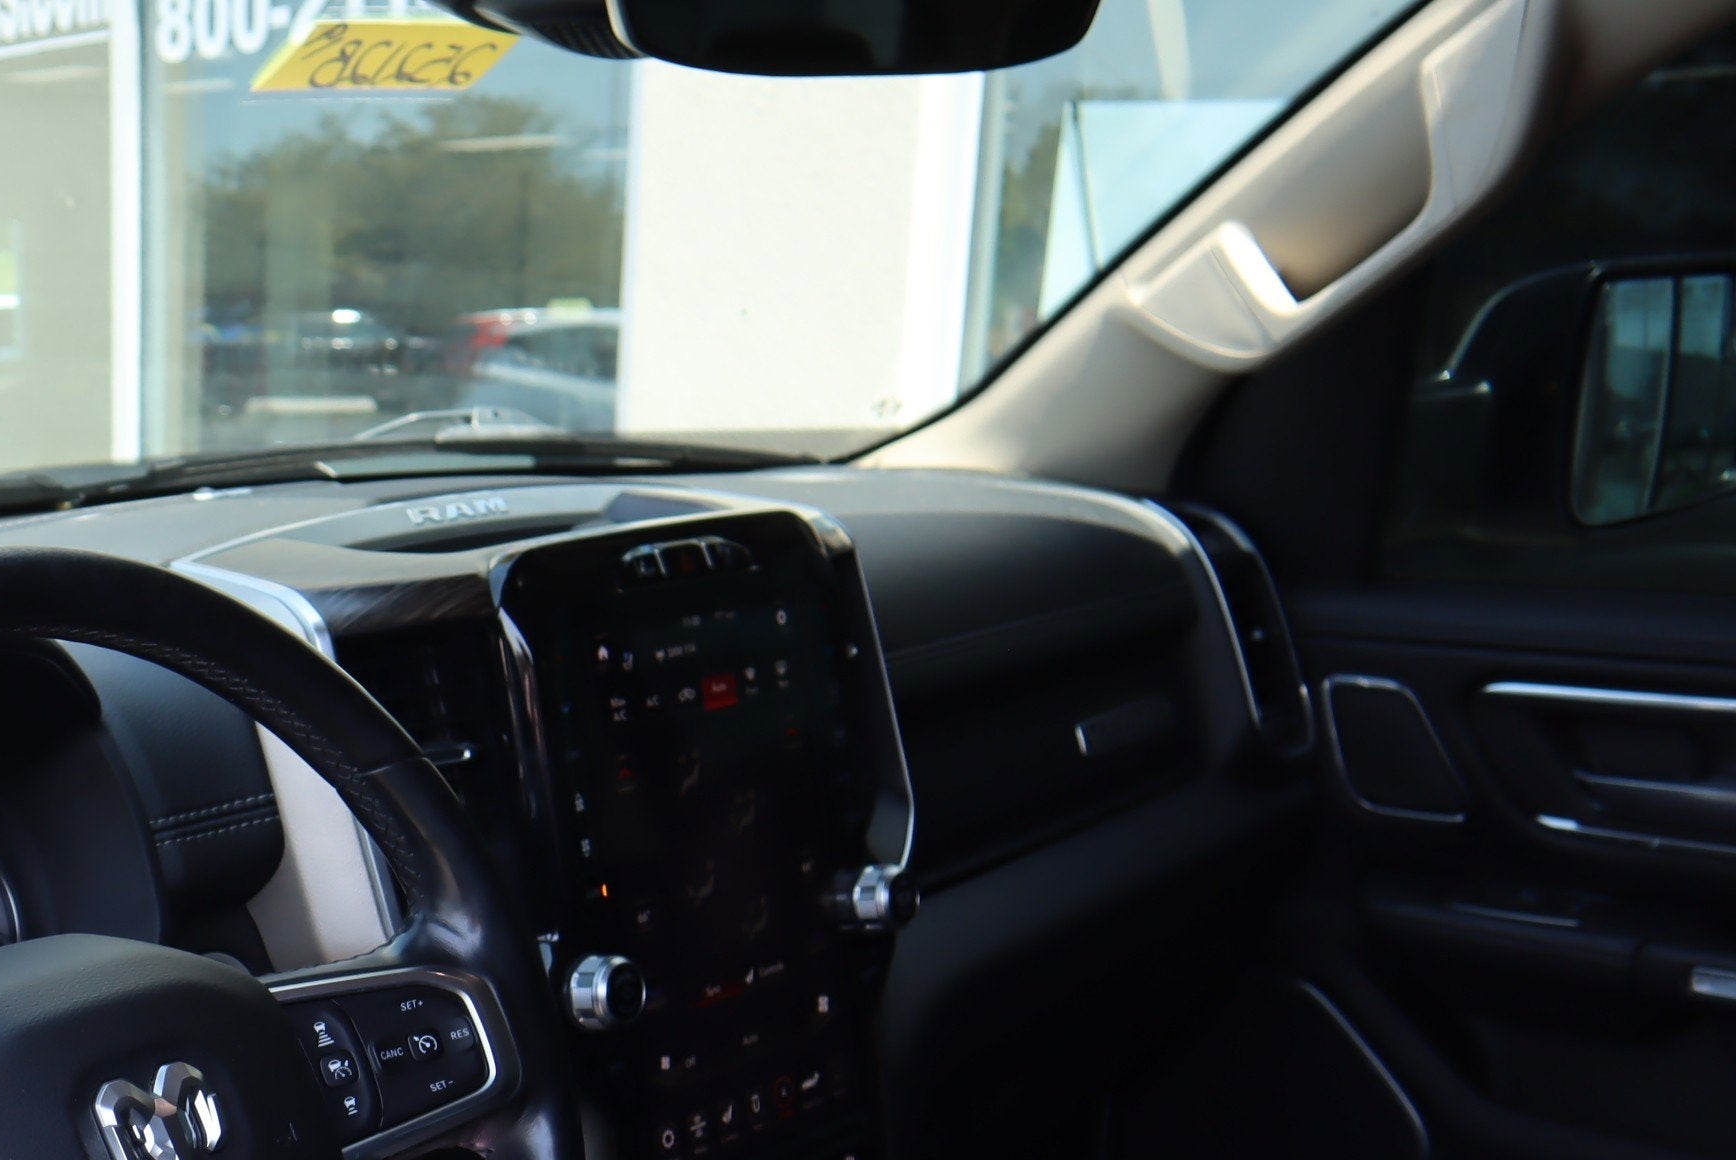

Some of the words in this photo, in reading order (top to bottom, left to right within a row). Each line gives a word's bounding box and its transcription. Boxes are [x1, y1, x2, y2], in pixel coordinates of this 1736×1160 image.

[406, 496, 509, 525] RAM
[450, 1027, 470, 1040] RES
[380, 1047, 404, 1060] CANC
